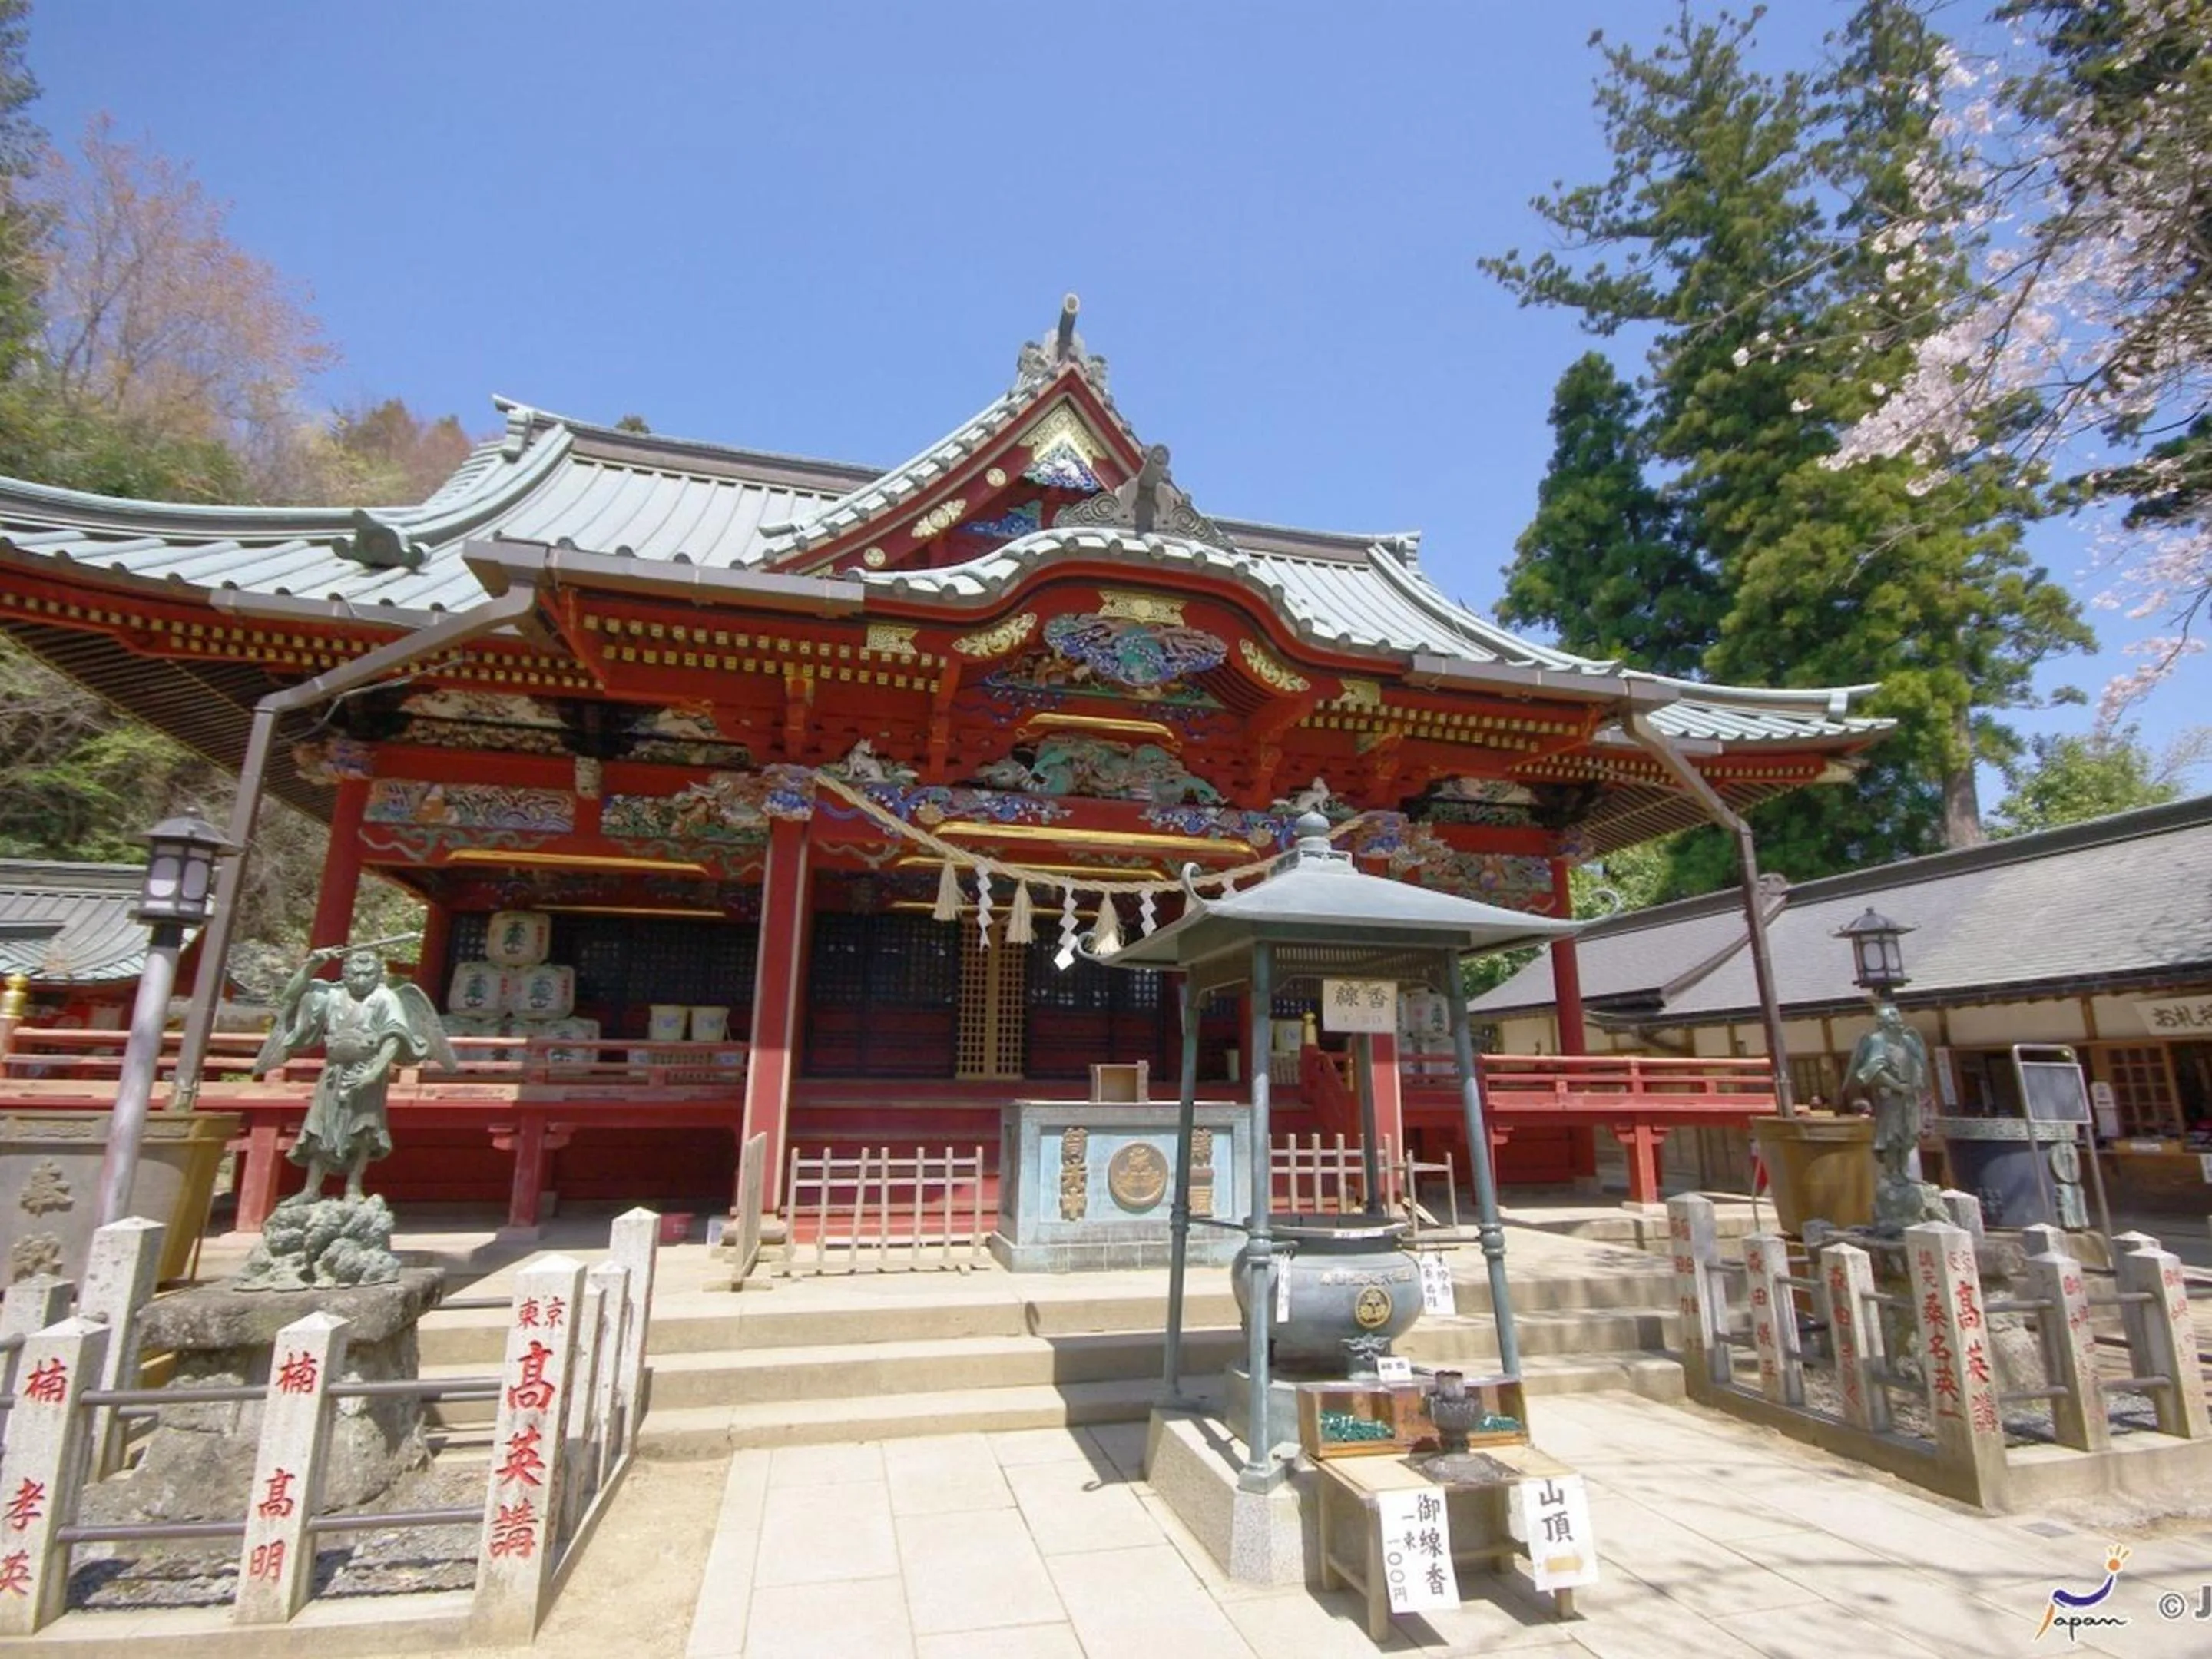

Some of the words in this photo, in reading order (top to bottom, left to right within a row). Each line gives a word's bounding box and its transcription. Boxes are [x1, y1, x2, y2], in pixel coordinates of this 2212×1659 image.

[518, 1296, 565, 1329] 東京
[1539, 1479, 1575, 1543] 山頂
[1418, 1493, 1447, 1596] 御線香
